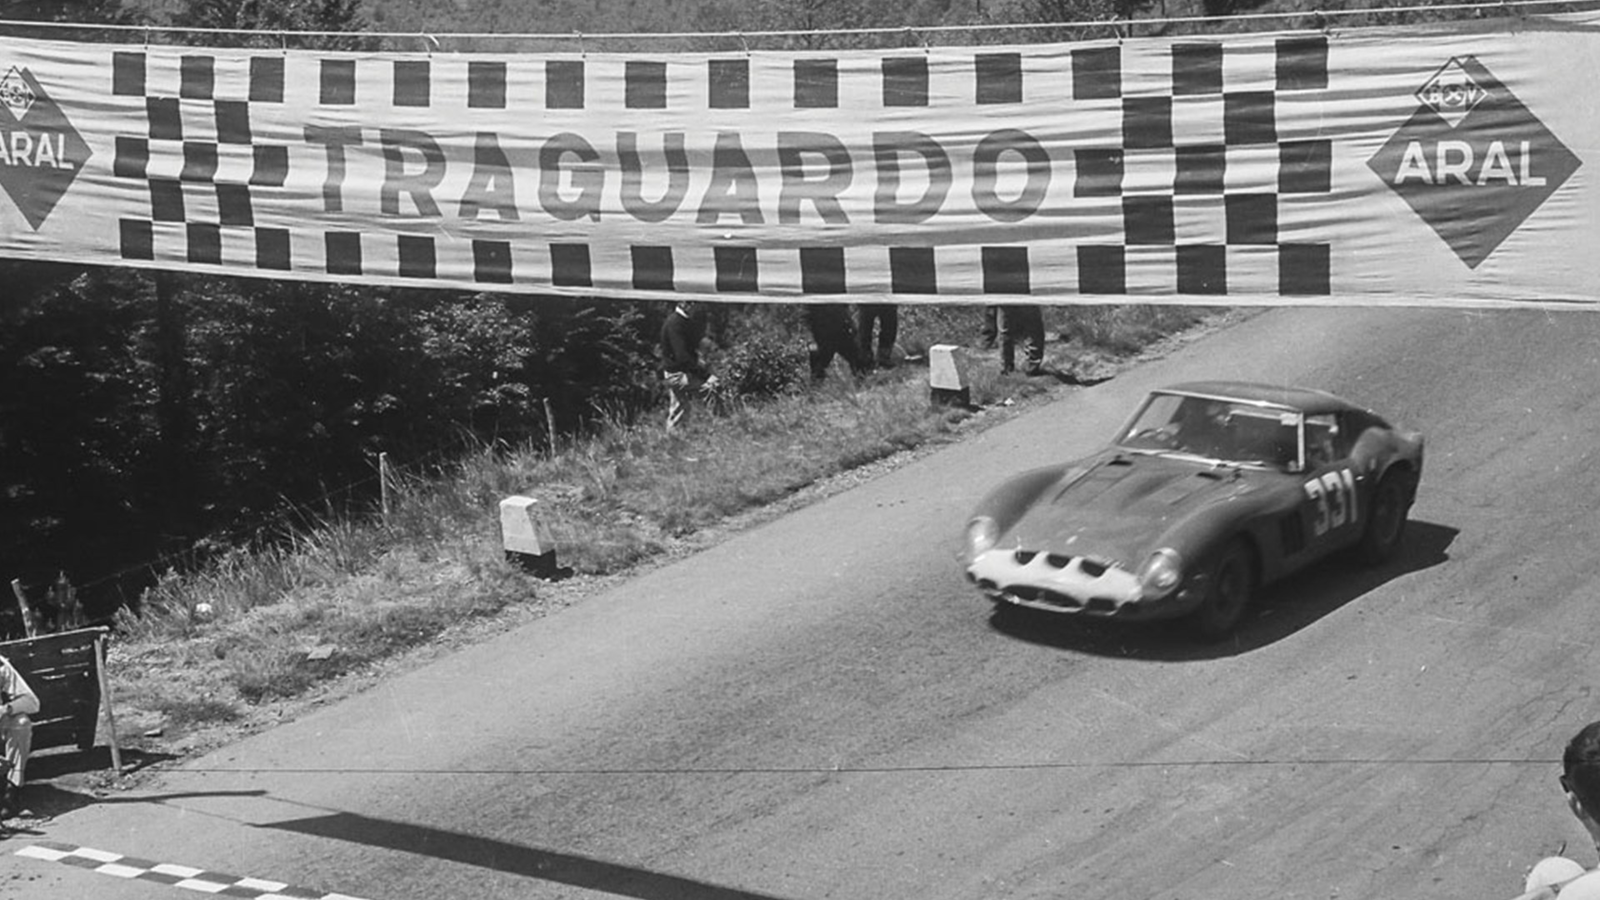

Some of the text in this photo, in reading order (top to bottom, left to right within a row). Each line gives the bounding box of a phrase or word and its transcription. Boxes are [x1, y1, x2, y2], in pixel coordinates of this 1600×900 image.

[303, 125, 1052, 224] TRAGUARDO
[1394, 141, 1547, 186] ARAL
[1304, 468, 1358, 536] 331
